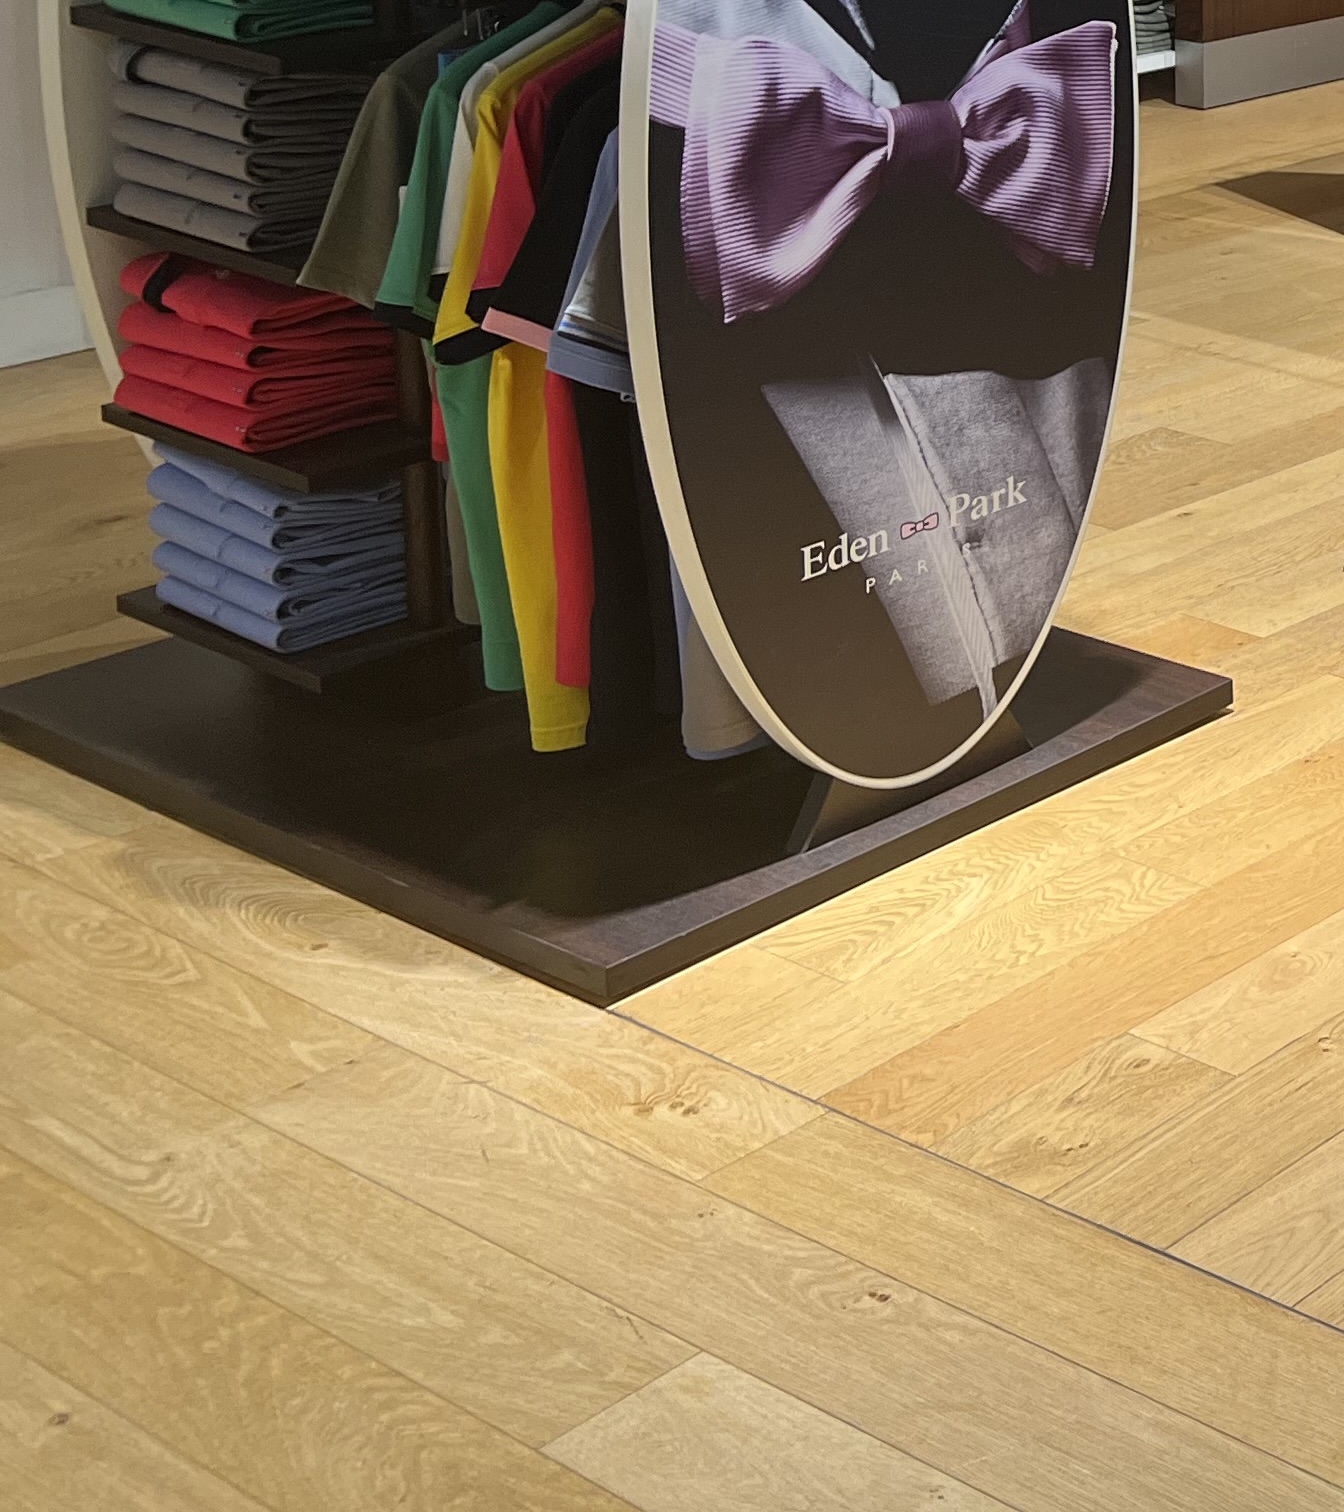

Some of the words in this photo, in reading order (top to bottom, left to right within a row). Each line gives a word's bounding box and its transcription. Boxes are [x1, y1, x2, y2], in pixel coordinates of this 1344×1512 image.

[800, 528, 891, 583] Eden
[948, 475, 1028, 529] Park
[865, 542, 972, 594] PARS
